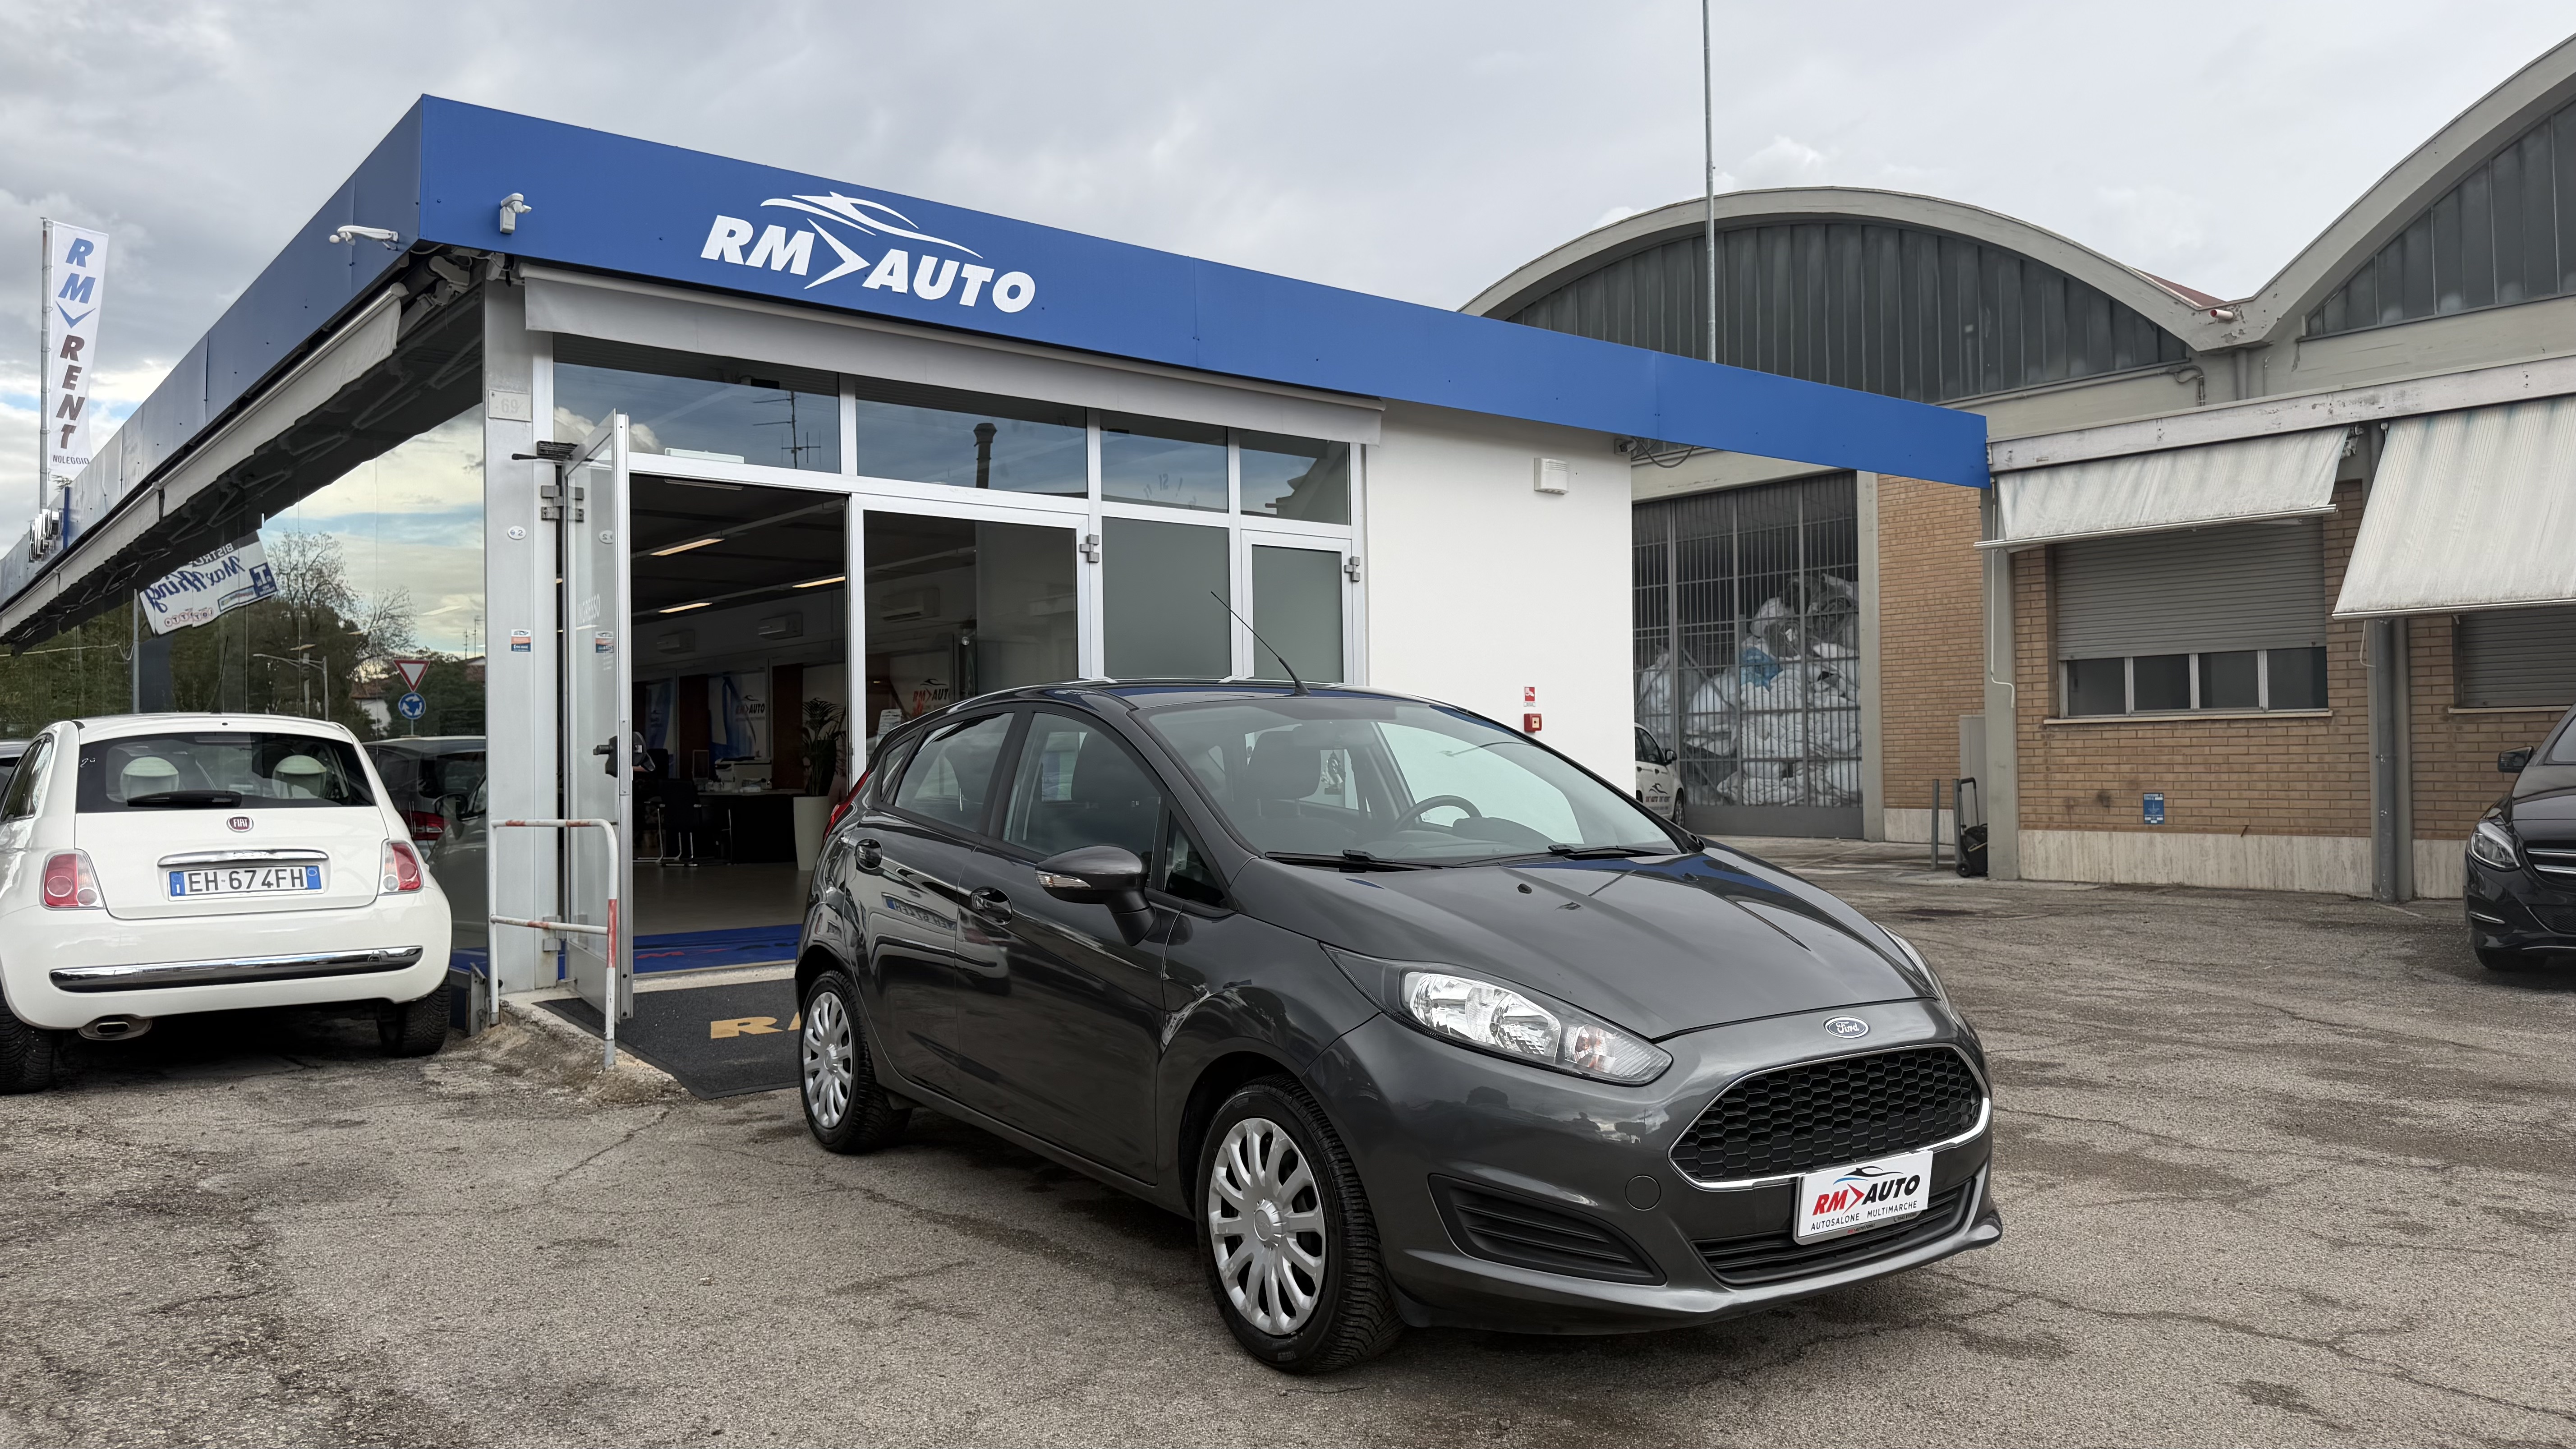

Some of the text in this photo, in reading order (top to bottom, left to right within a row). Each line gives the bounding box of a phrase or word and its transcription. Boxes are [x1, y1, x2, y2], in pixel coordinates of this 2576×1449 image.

[58, 238, 96, 304] RM
[700, 215, 1036, 313] RM AUTO
[56, 334, 85, 450] RENT
[931, 688, 950, 701] AUT
[749, 703, 765, 714] AUTO
[233, 819, 248, 827] FIAT
[188, 871, 219, 892] EH
[229, 869, 304, 890] 674FH
[1835, 1021, 1860, 1034] Ford
[1812, 1175, 1921, 1216] RM AUTO
[1811, 1200, 1917, 1231] AUTOSALONE MULTIMARCHE
